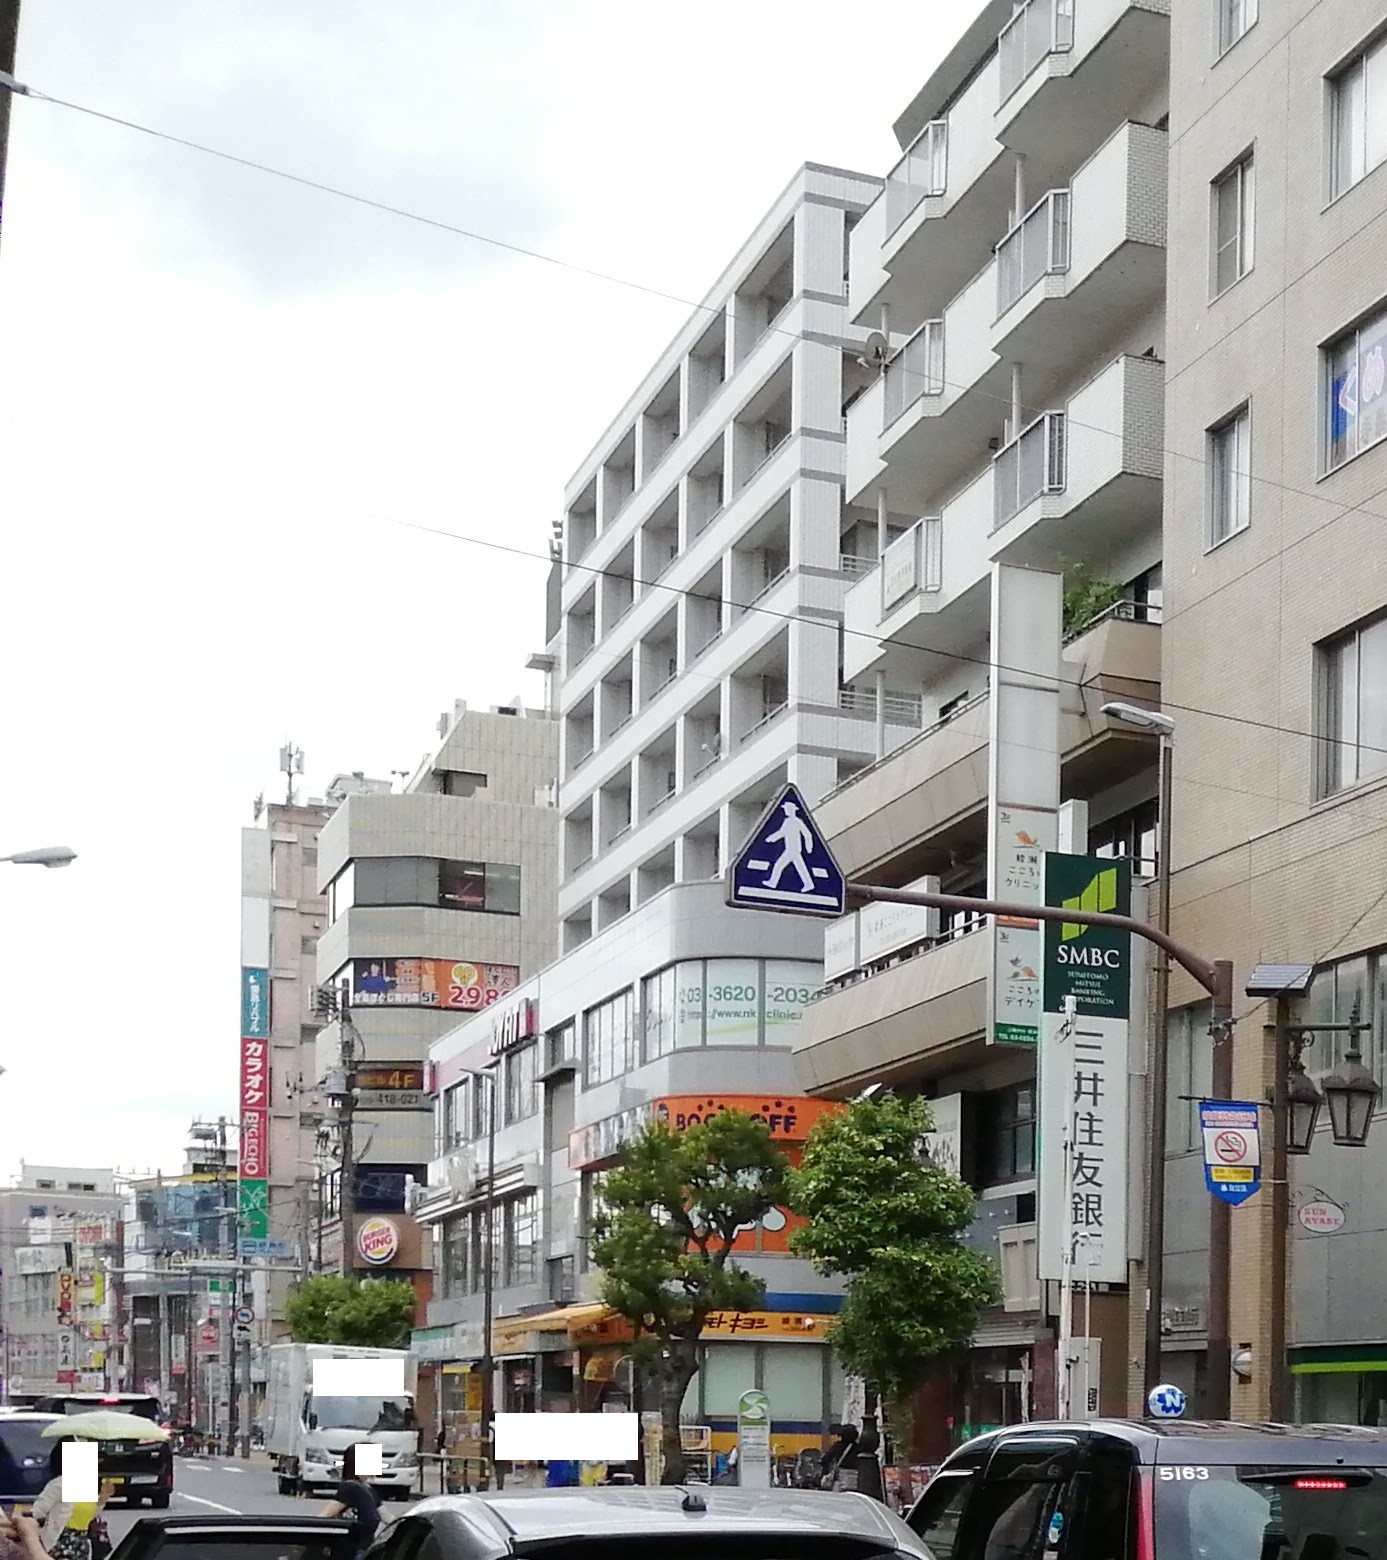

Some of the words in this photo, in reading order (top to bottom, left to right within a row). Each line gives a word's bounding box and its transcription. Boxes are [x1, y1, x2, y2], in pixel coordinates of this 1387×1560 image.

[1057, 945, 1120, 968] SMBC
[1062, 995, 1114, 1005] CPORATION
[244, 1041, 264, 1104] カラオケ
[244, 1111, 260, 1138] BIG
[244, 1140, 260, 1175] ECHO
[1072, 1031, 1104, 1266] 三井住友銀行
[1304, 1208, 1327, 1216] SUN
[1304, 1217, 1341, 1225] AYASE
[363, 1235, 393, 1254] KING
[1161, 1467, 1209, 1480] 5163
